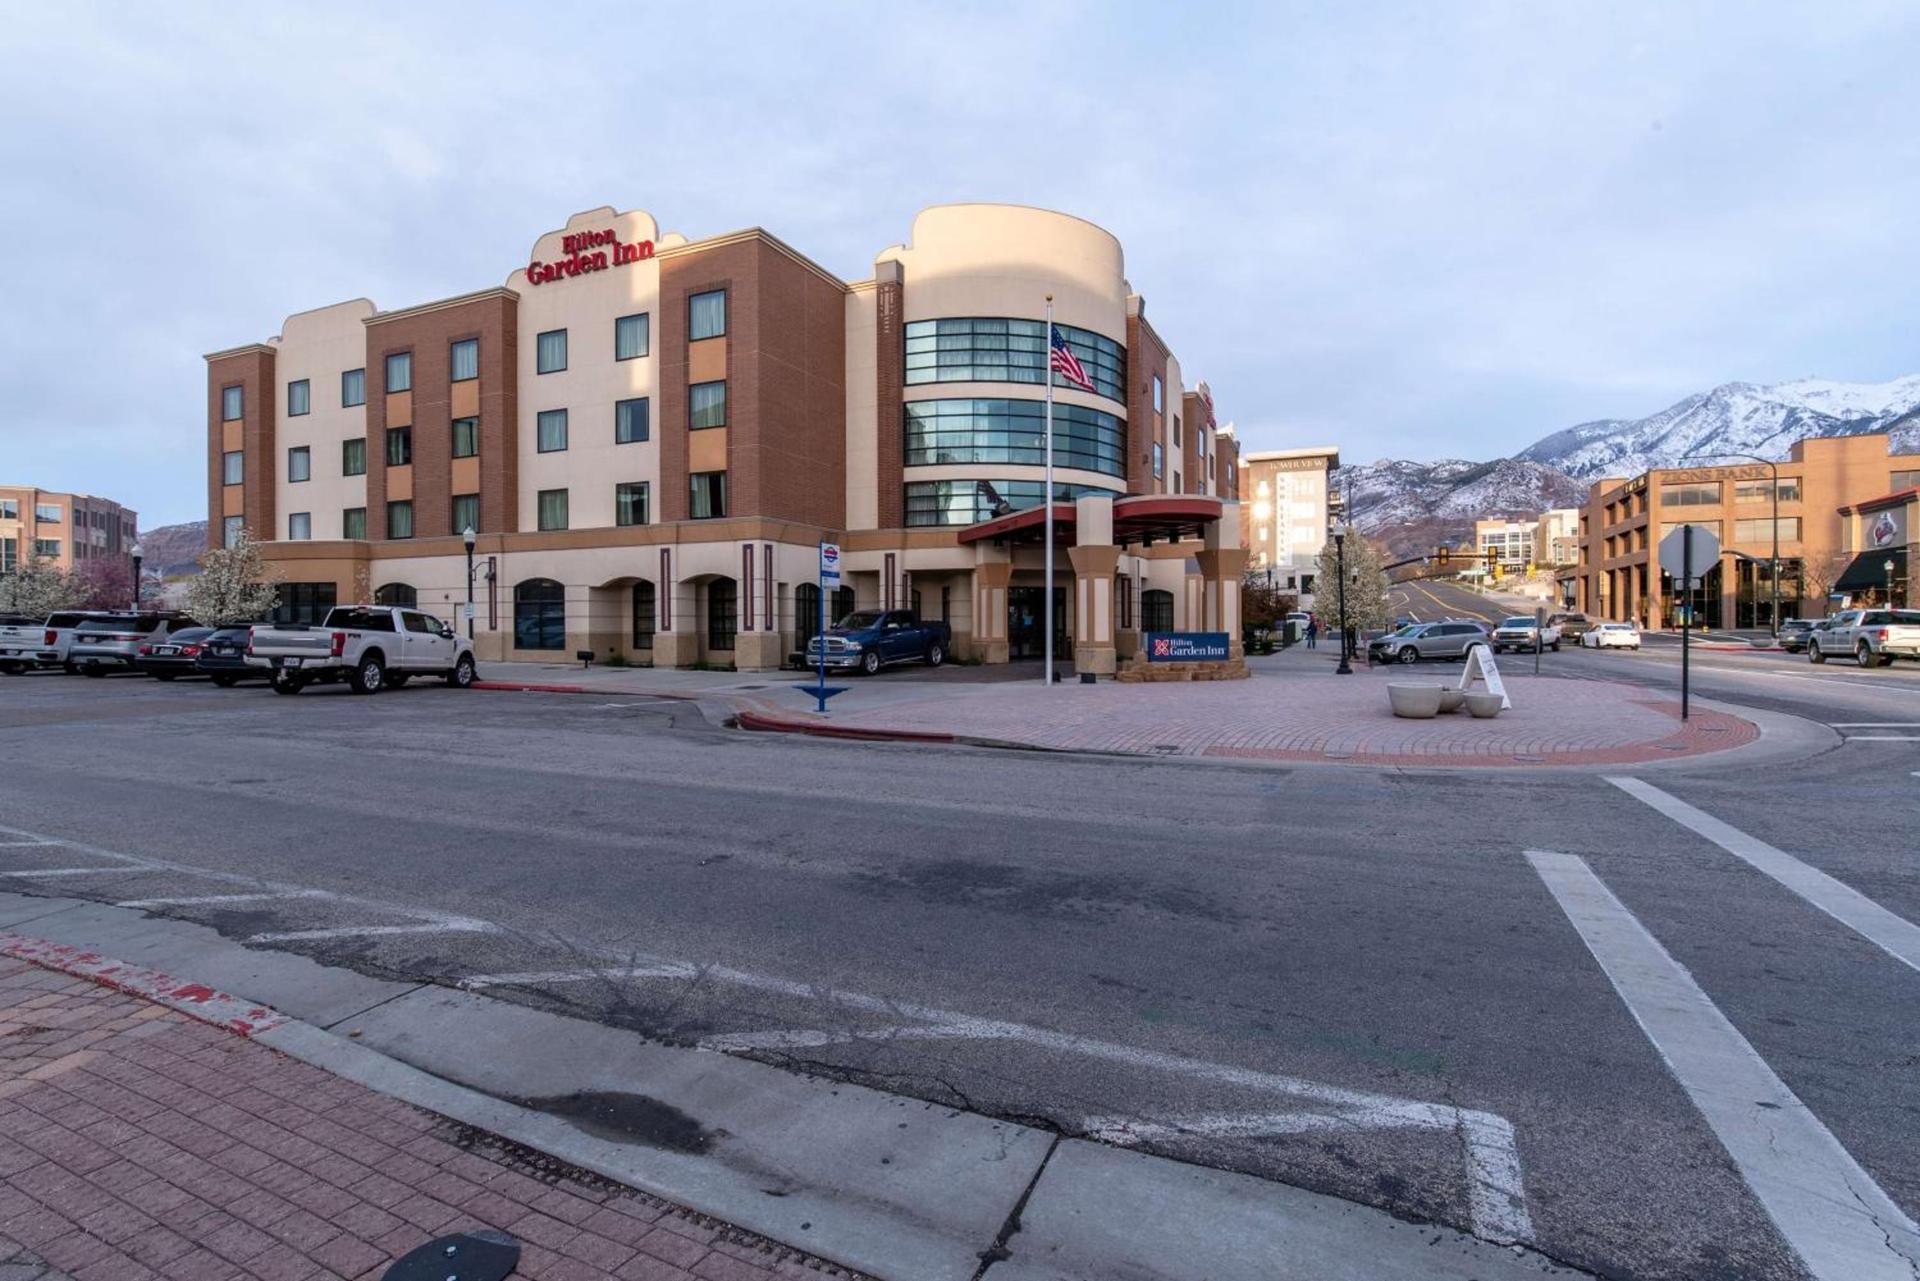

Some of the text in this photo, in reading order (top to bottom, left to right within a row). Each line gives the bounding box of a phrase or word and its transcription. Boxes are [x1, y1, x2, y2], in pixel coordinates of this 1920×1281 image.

[562, 229, 616, 254] Hilton
[527, 239, 655, 285] Garden Inn
[1661, 467, 1768, 482] ZIONS BANK
[1170, 646, 1225, 656] Garden Inn
